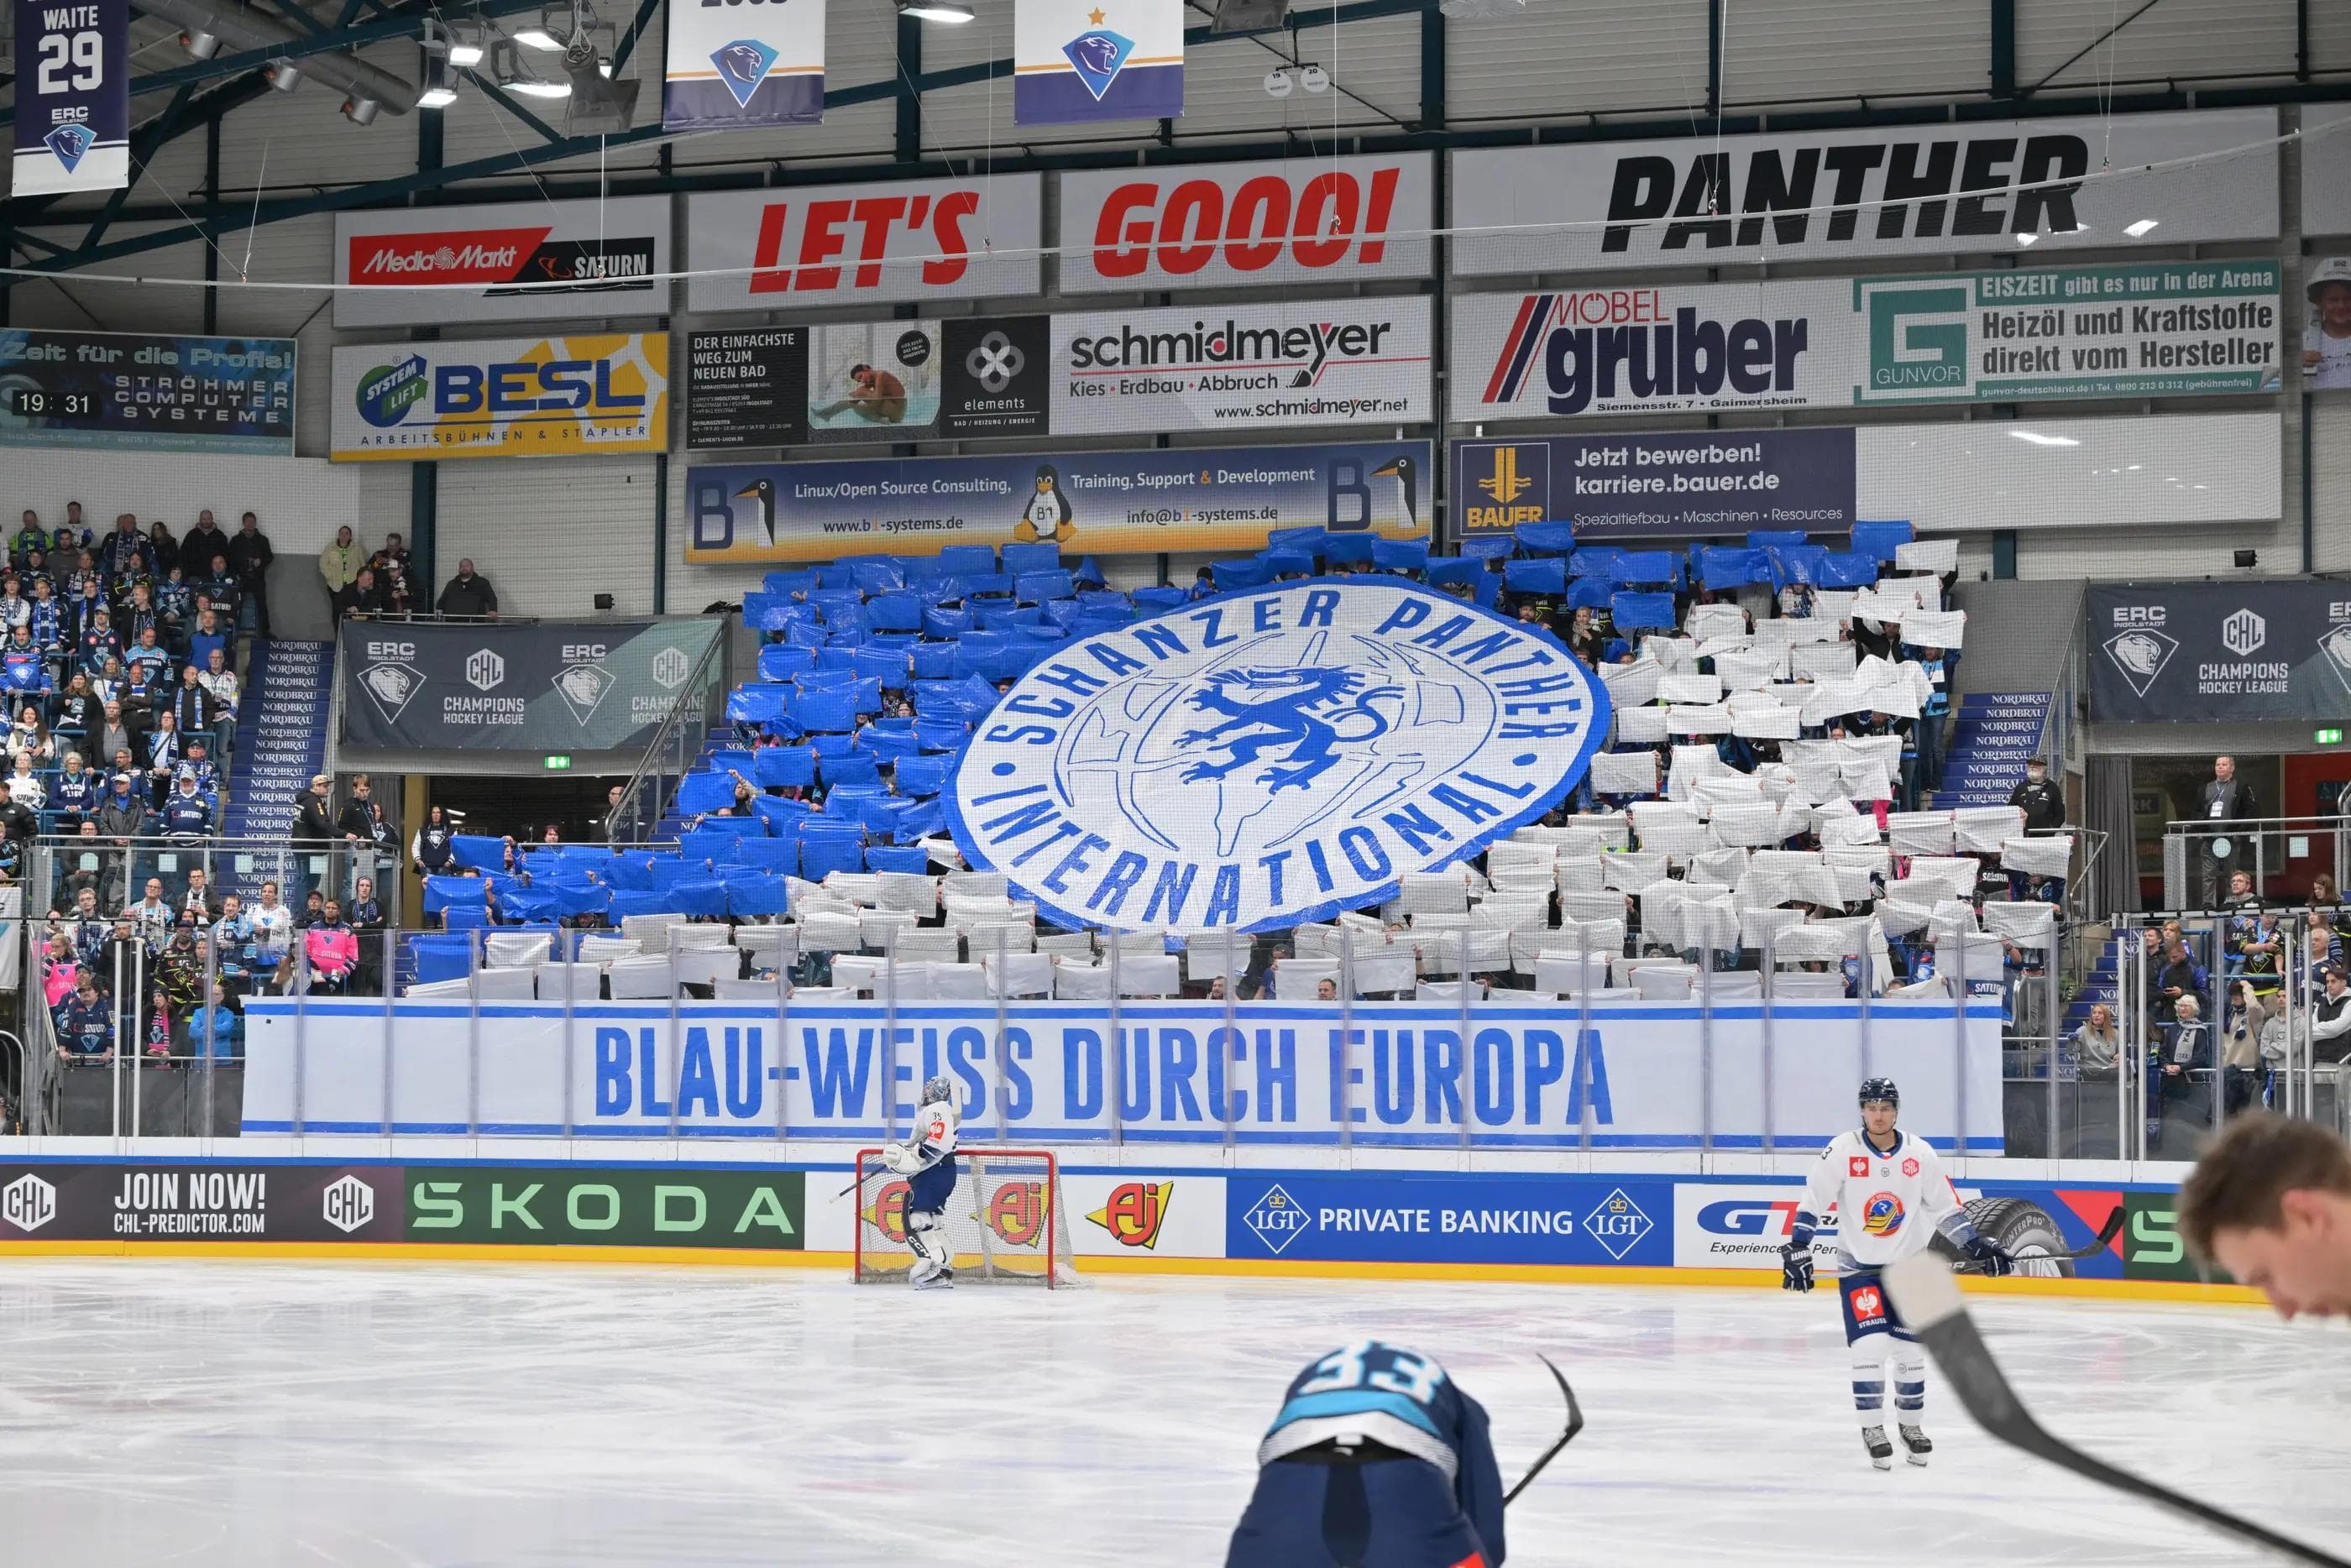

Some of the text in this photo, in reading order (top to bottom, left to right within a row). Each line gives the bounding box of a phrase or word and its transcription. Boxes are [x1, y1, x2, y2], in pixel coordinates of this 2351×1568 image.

[43, 5, 98, 30] WAITE
[39, 30, 102, 94] 29
[51, 107, 88, 120] ERC
[1601, 135, 2087, 252] PANTHER
[1093, 168, 1401, 278] GOOO!
[749, 191, 980, 294] LET'S
[575, 254, 647, 279] SATURN
[1982, 269, 2274, 298] EISZEIT gibt es nur in der Arena
[1553, 290, 1670, 326] MÖBEL
[1982, 301, 2273, 340] Heizöl und Kraftstoffe
[694, 333, 794, 349] DER EINFACHSTE
[1071, 321, 1390, 374] schmidmeyer
[3, 342, 291, 368] Zeit für die Profis!
[694, 350, 752, 364] WEG ZUM
[1546, 307, 1808, 415] gruber
[1982, 338, 2274, 375] direkt vom Hersteller
[366, 362, 417, 401] SYSTEM
[694, 365, 767, 379] NEUEN BAD
[1877, 365, 1961, 385] GUNVOR
[435, 360, 646, 415] BESL
[1070, 373, 1278, 397] Kies Erdbau Abbruch
[1982, 386, 2089, 398] gunvor-deutschland.de
[2165, 380, 2183, 389] 312
[115, 390, 288, 410] COMPUTER
[390, 383, 418, 410] LIFT
[965, 398, 1025, 410] elements
[1597, 396, 1807, 412] Siemensstr. 7 Gaimersheim
[123, 407, 279, 424] SYSTEME
[1214, 397, 1408, 419] www.schmidmeyer.net
[361, 426, 646, 446] ARBEITSBÜHNEN & STAPLER
[1574, 442, 1762, 468] Jetzt bewerben!
[795, 476, 1012, 500] Linux/Open Source Consulting,
[1071, 468, 1316, 490] Training, Support & Development
[1574, 471, 1779, 496] karriere.bauer.de
[1467, 505, 1543, 528] BAUER
[1574, 506, 1842, 529] Spezialtiefbau Maschinen Resources
[2113, 606, 2166, 621] ERC
[2227, 614, 2262, 651] CHL
[270, 640, 322, 651] NORDBRÄU
[368, 642, 415, 656] ERC
[562, 644, 605, 658] ERC
[268, 653, 321, 663] NORDBRÄU
[988, 589, 1580, 746] SCHANZER PANTHER
[267, 665, 319, 675] NORDBRÄU
[469, 653, 501, 685] CHL
[2199, 662, 2289, 680] CHAMPIONS
[265, 677, 317, 687] NORDBRÄU
[2199, 680, 2288, 694] HOCKEY LEAGUE
[264, 690, 317, 700] NORDBRÄU
[443, 696, 525, 713] CHAMPIONS
[1992, 693, 2050, 705] NORDBRÄU
[262, 703, 316, 713] NORDBRÄU
[1986, 708, 2045, 719] NORDBRÄU
[259, 714, 313, 725] NORDBRÄU
[443, 713, 524, 724] HOCKEY LEAGUE
[1981, 721, 2039, 733] NORDBRÄU
[258, 728, 312, 738] NORDBRÄU
[1976, 735, 2035, 747] NORDBRÄU
[255, 740, 310, 750] NORDBRÄU
[254, 753, 308, 764] NORDBRÄU
[1971, 750, 2032, 761] NORDBRÄU
[252, 766, 306, 776] NORDBRÄU
[251, 778, 306, 789] NORDBRÄU
[1960, 793, 2013, 804] NORDBRÄ
[971, 771, 1537, 928] INTERNATIONAL
[595, 1026, 1614, 1126] BLAU-WEISS DURCH EUROPA
[1903, 1160, 1918, 1174] CHL
[114, 1173, 265, 1210] JOIN NOW!
[8, 1181, 52, 1224] CHL
[327, 1182, 370, 1226] CHL
[114, 1213, 264, 1233] CHL-PREDICTOR.COM
[1256, 1210, 1301, 1231] LGT
[1320, 1208, 1573, 1236] PRIVATE BANKING
[1595, 1215, 1642, 1236] LGT
[1858, 1317, 1887, 1329] STRAUSS
[1298, 1339, 1444, 1404] 33
